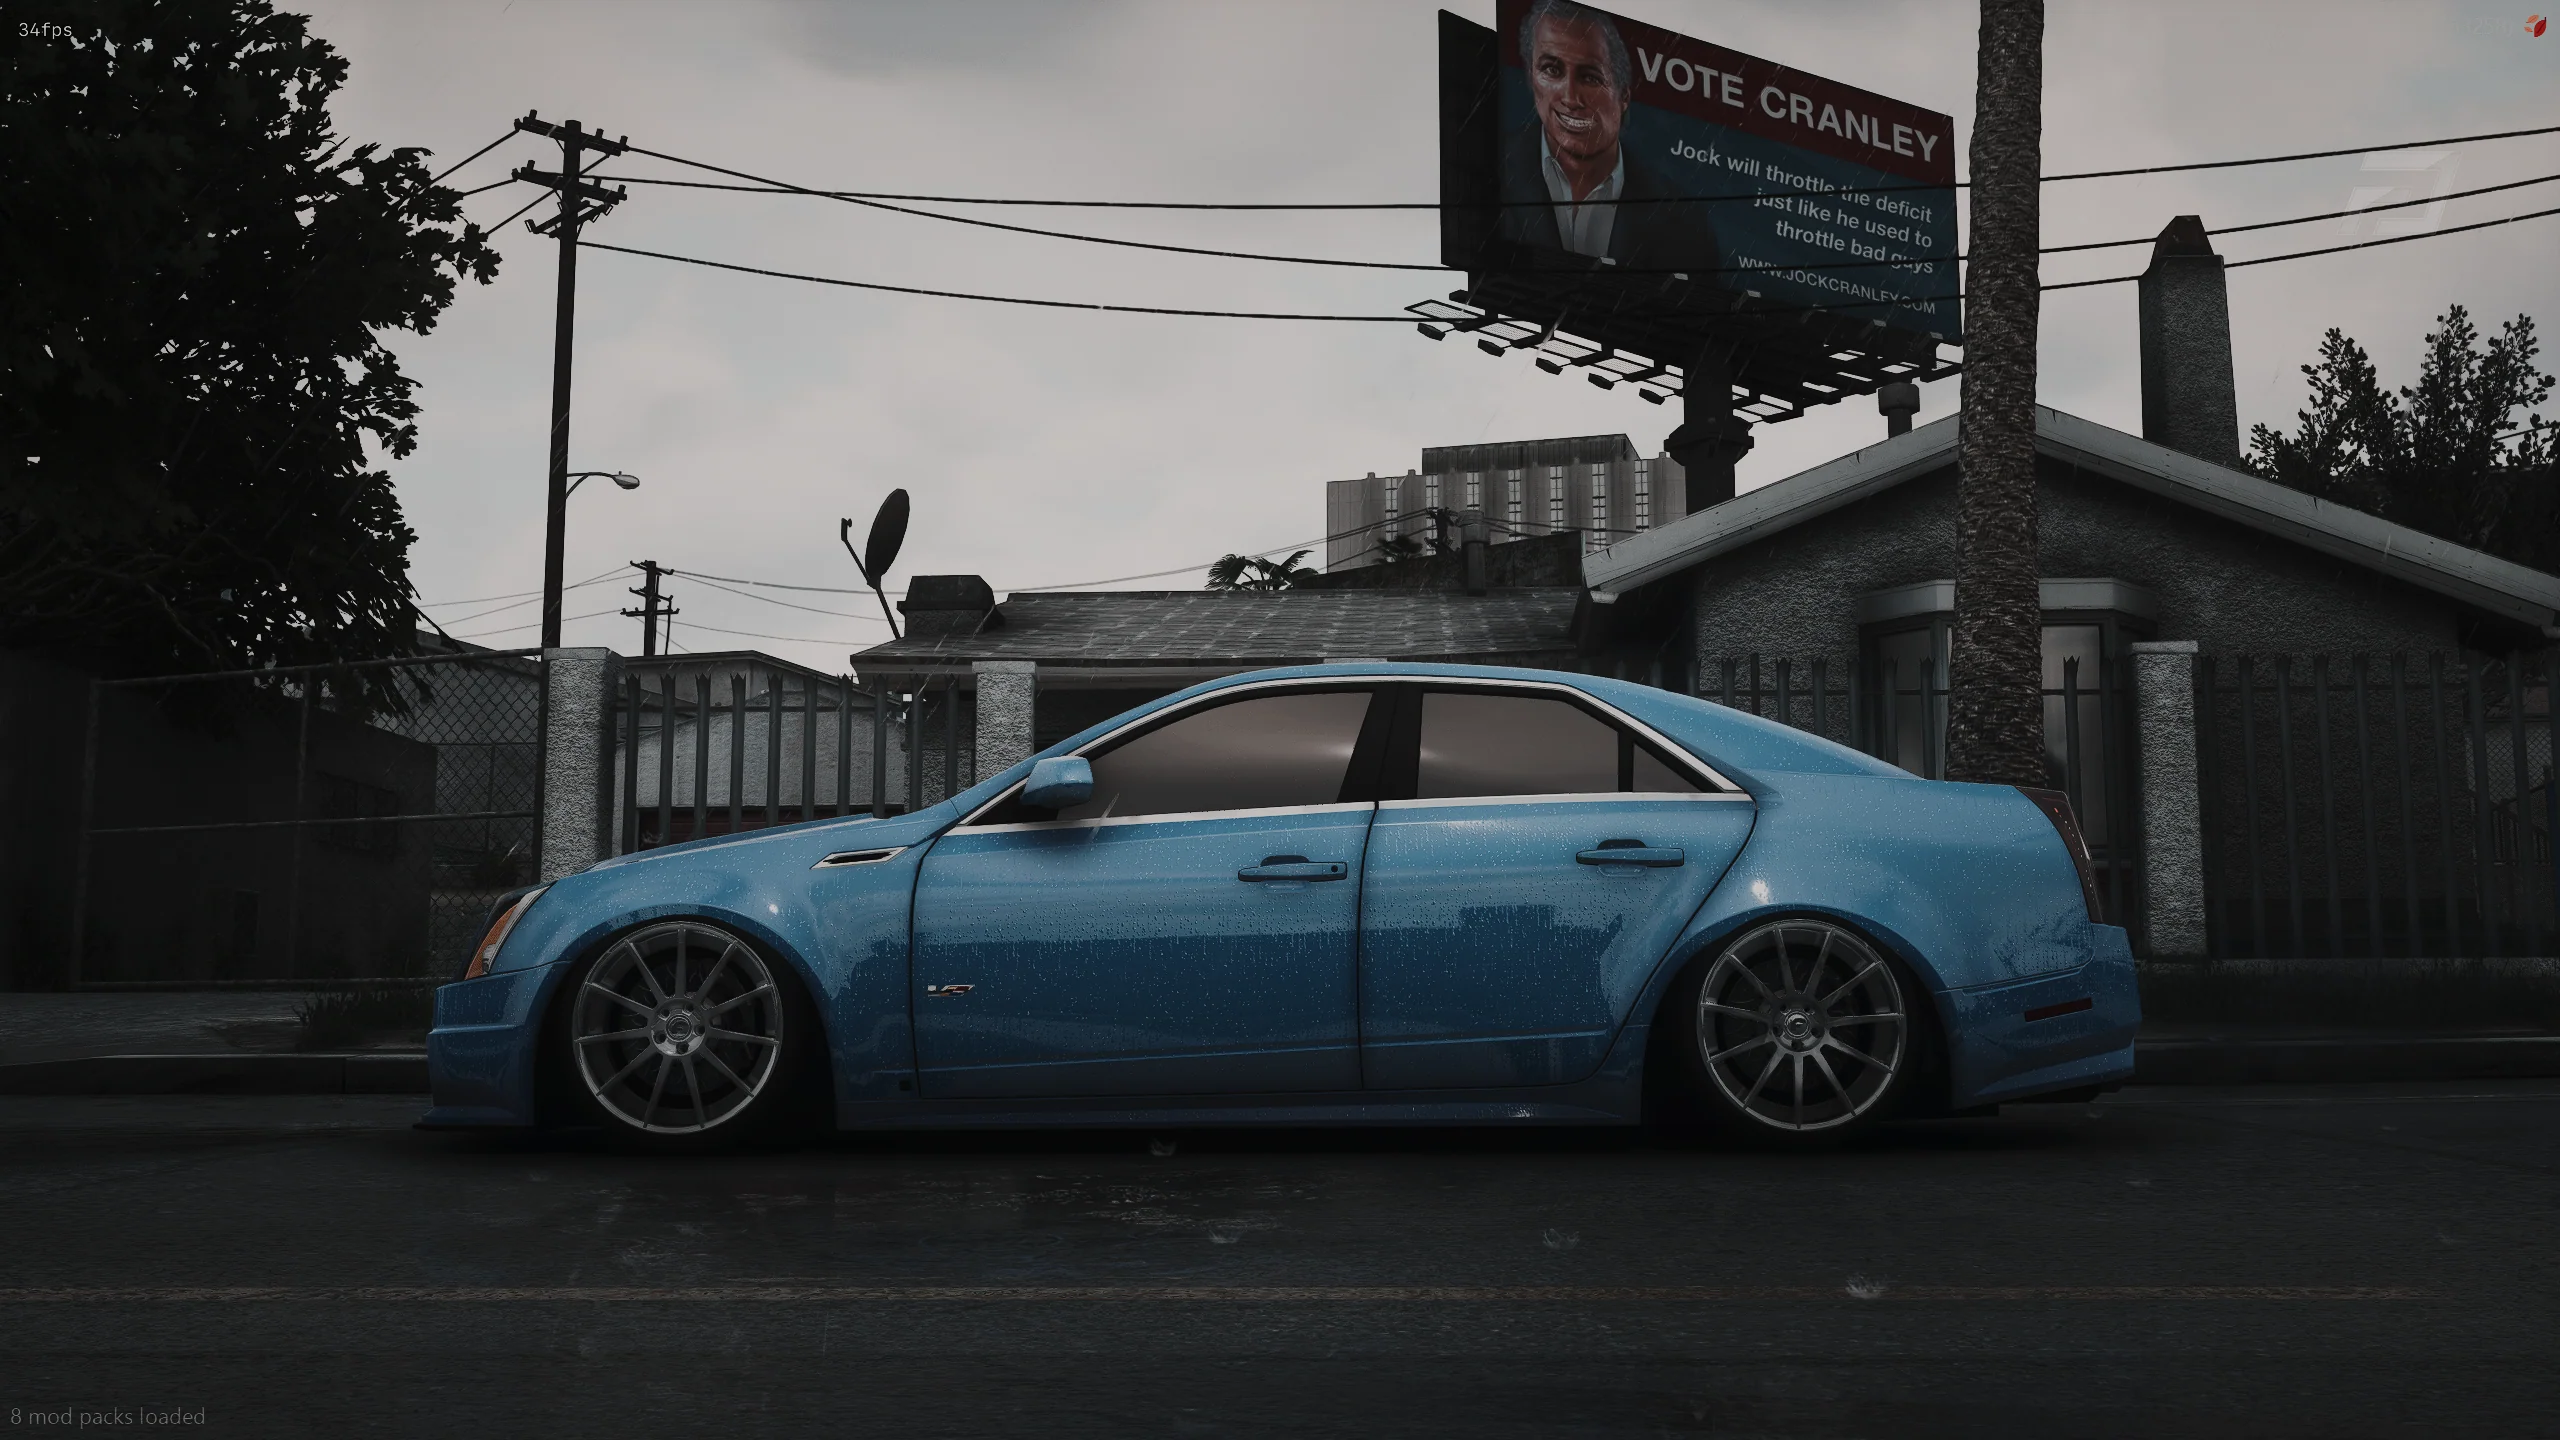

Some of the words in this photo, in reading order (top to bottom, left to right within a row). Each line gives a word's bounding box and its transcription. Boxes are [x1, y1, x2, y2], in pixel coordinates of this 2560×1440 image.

[1636, 47, 1745, 109] VOTE
[1761, 86, 1939, 163] CRANLEY
[1670, 139, 1721, 167] Jock
[1727, 157, 1760, 178] will
[1766, 164, 1835, 197] throttle
[1841, 184, 1870, 206] the
[1876, 195, 1932, 224] deficit
[1753, 187, 1794, 212] just
[1797, 198, 1832, 222] like
[1836, 208, 1860, 229] he
[1865, 218, 1909, 243] used
[1915, 230, 1933, 248] to
[1776, 220, 1845, 252] throttle
[1850, 238, 1886, 262] bad
[1890, 253, 1934, 275] guys
